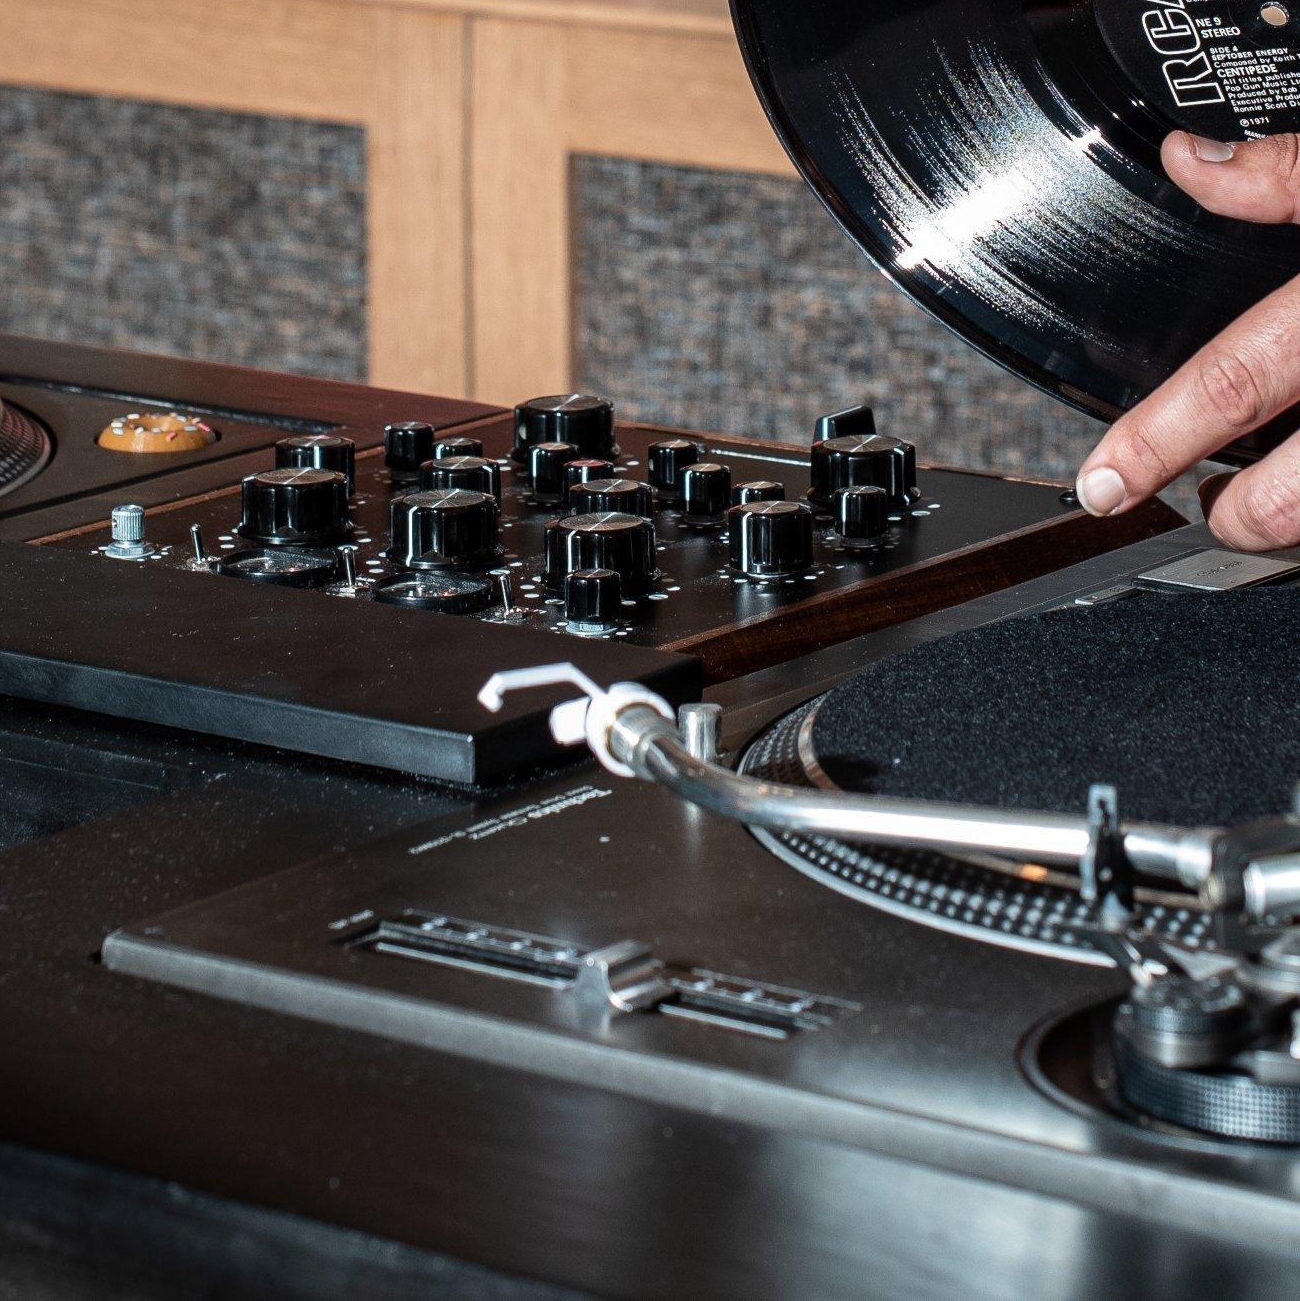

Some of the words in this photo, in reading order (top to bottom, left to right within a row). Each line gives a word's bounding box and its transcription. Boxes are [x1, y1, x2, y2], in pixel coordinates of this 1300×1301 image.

[1195, 18, 1212, 28] NE
[1214, 17, 1221, 26] 9
[1201, 26, 1240, 39] STEREO
[1209, 46, 1230, 55] SIDE
[1211, 51, 1253, 61] SEPTOBER
[1255, 47, 1288, 57] ENERGY
[1214, 58, 1258, 69] Composed
[1260, 56, 1270, 65] by
[1273, 55, 1296, 63] Keith
[1216, 63, 1278, 78] CENTIPEDE
[1222, 77, 1237, 85] All
[1238, 75, 1263, 84] titles
[1225, 85, 1241, 93] Pop
[1242, 83, 1260, 91] Gun
[1262, 80, 1288, 89] Music
[1227, 90, 1267, 100] Produced
[1268, 87, 1280, 95] by
[1281, 86, 1298, 94] Bob
[1230, 97, 1274, 107] Executive
[1233, 104, 1263, 113] Ronnie
[1264, 101, 1288, 111] Scott
